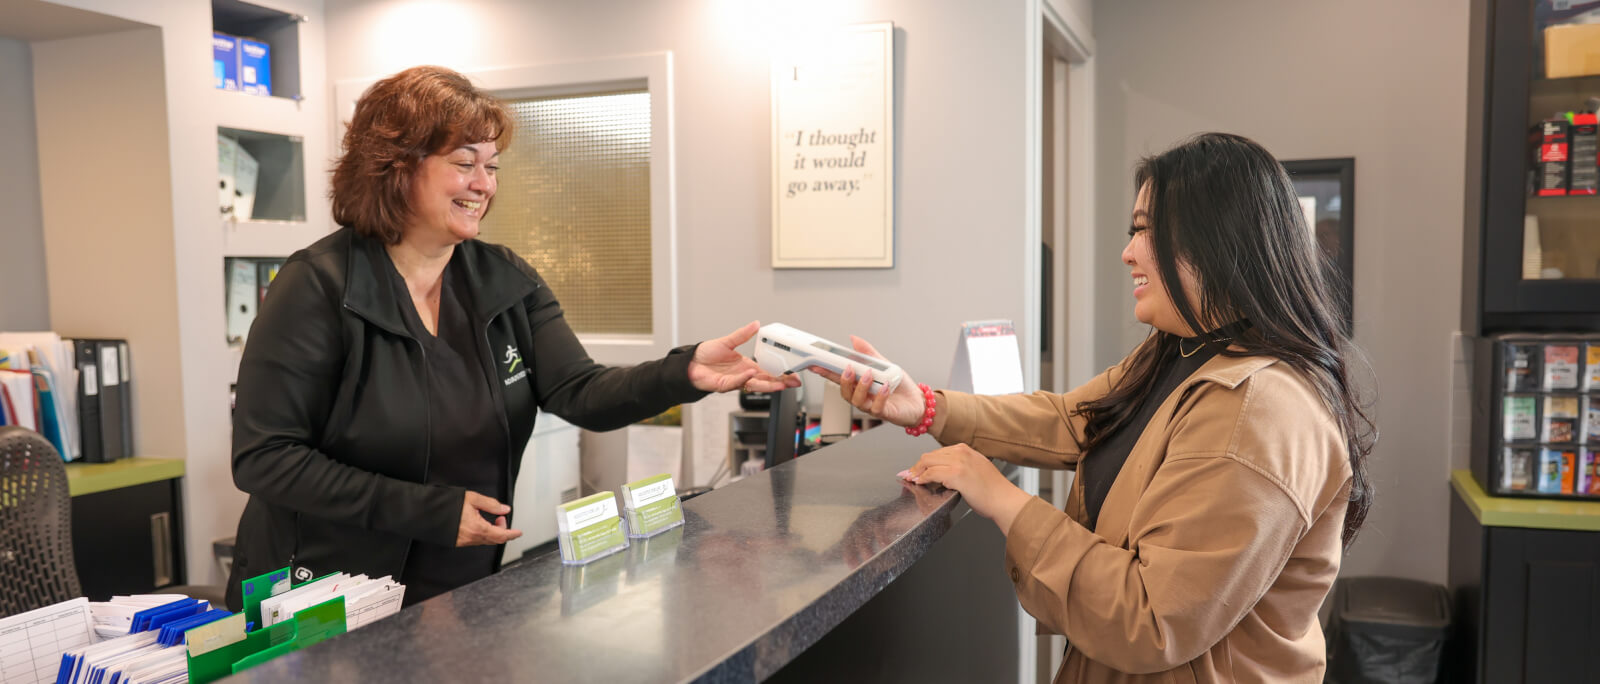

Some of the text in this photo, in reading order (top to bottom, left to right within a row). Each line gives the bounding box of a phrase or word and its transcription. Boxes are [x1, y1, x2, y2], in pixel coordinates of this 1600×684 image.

[808, 127, 877, 150] thought
[793, 151, 866, 170] it would
[786, 180, 807, 198] go
